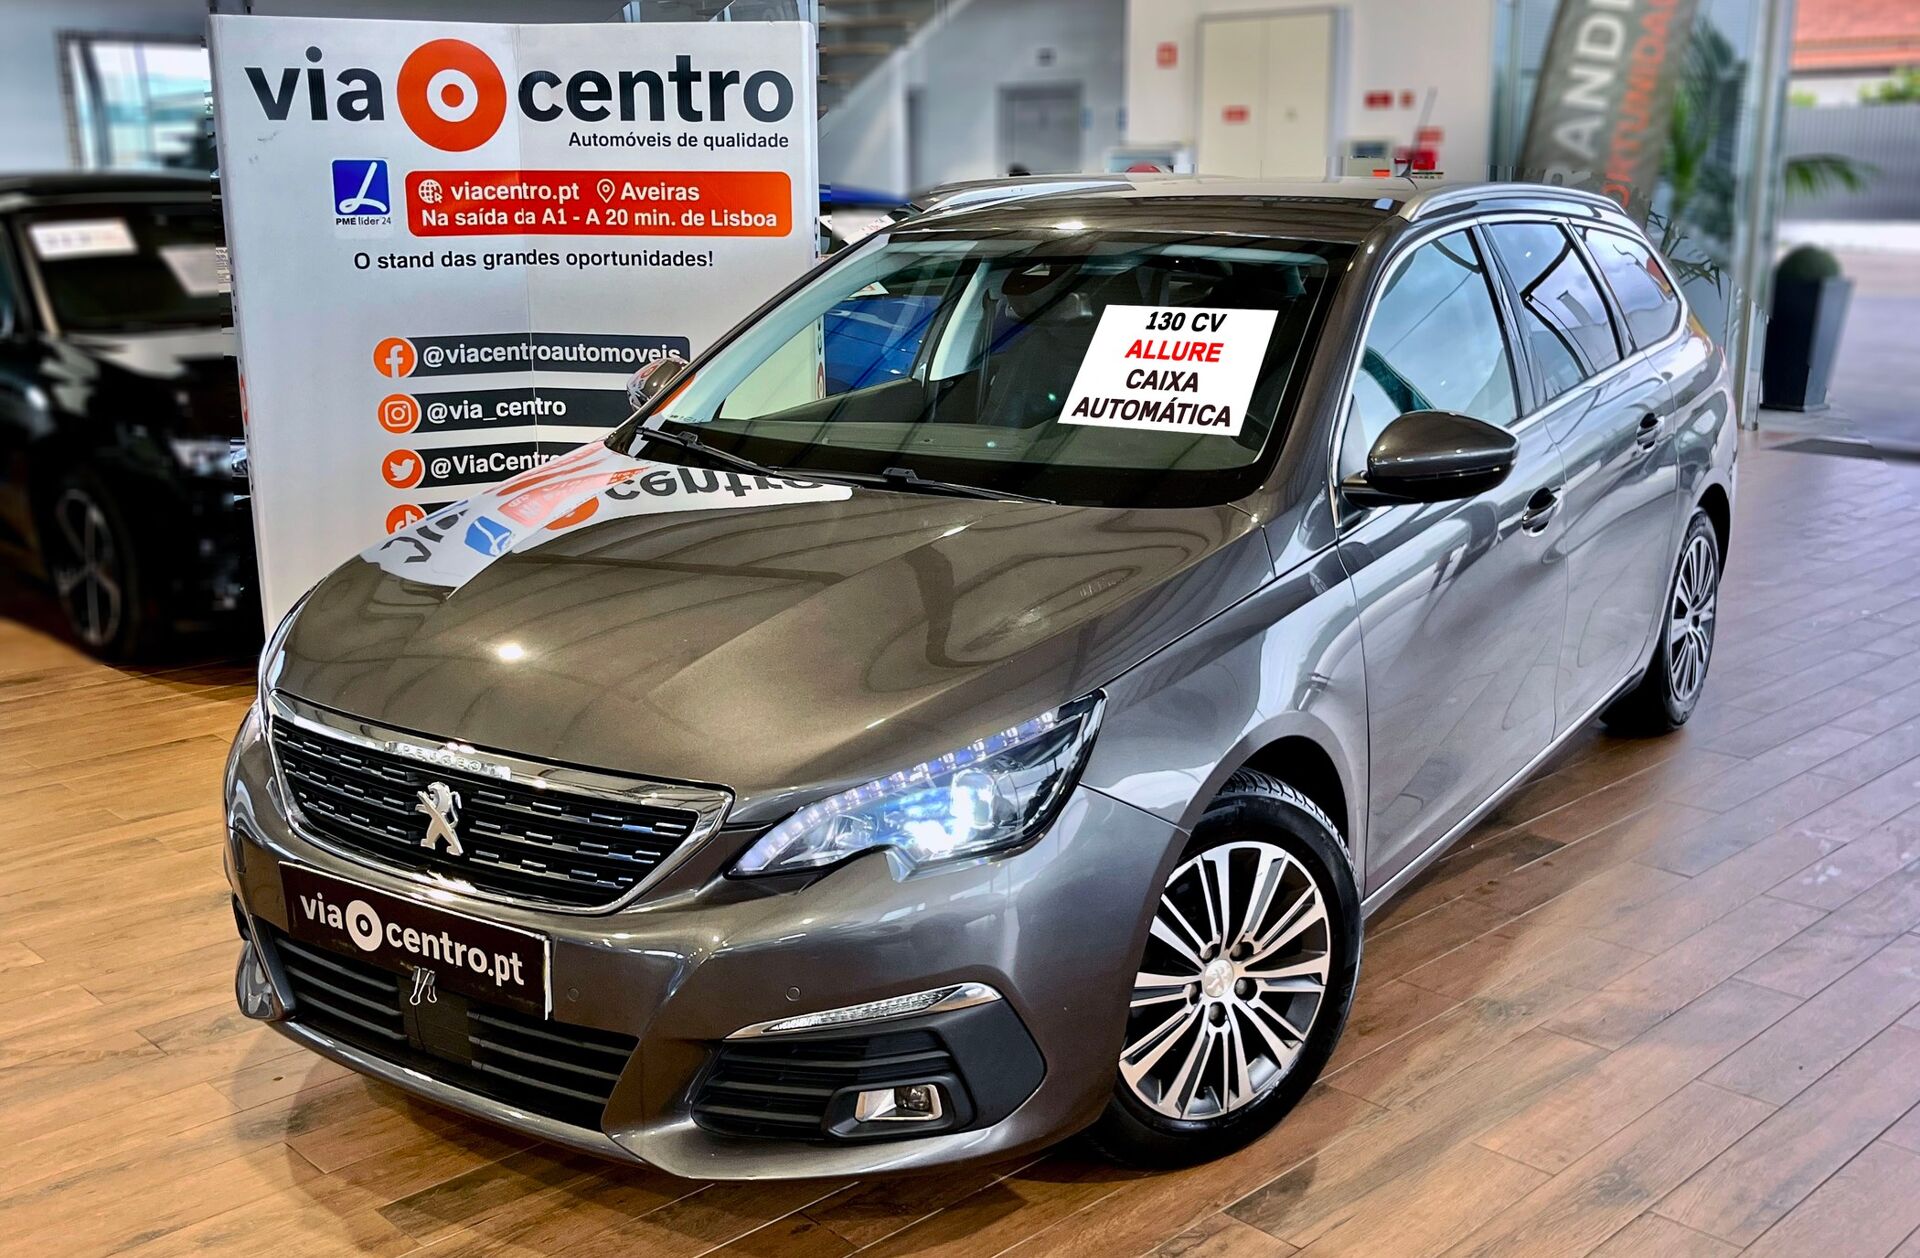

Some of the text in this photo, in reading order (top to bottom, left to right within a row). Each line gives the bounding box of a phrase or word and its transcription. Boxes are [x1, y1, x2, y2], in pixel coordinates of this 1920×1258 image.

[245, 46, 794, 123] via centro
[1541, 0, 1635, 185] RAND
[568, 132, 789, 151] Automóveis de qualidade
[450, 181, 700, 204] viacentro.pt Aveiras
[335, 217, 357, 226] PME
[422, 209, 449, 226] Na
[455, 208, 508, 226] saída
[514, 208, 536, 225] da
[542, 208, 567, 225] A1
[585, 208, 600, 225] A
[606, 209, 629, 226] 20
[634, 209, 676, 227] min.
[681, 209, 705, 227] de
[711, 210, 777, 227] Lisboa
[354, 249, 713, 270] O stand das grandes oportunidades!
[1145, 311, 1228, 333] 130 CV
[423, 344, 681, 368] @viacentroautomoveis
[1124, 339, 1224, 363] ALLURE
[1125, 368, 1199, 393] CAIXA
[427, 397, 567, 424] @via_centro
[1071, 396, 1231, 427] AUTOMÁTICA
[300, 892, 525, 987] via centro.pt
